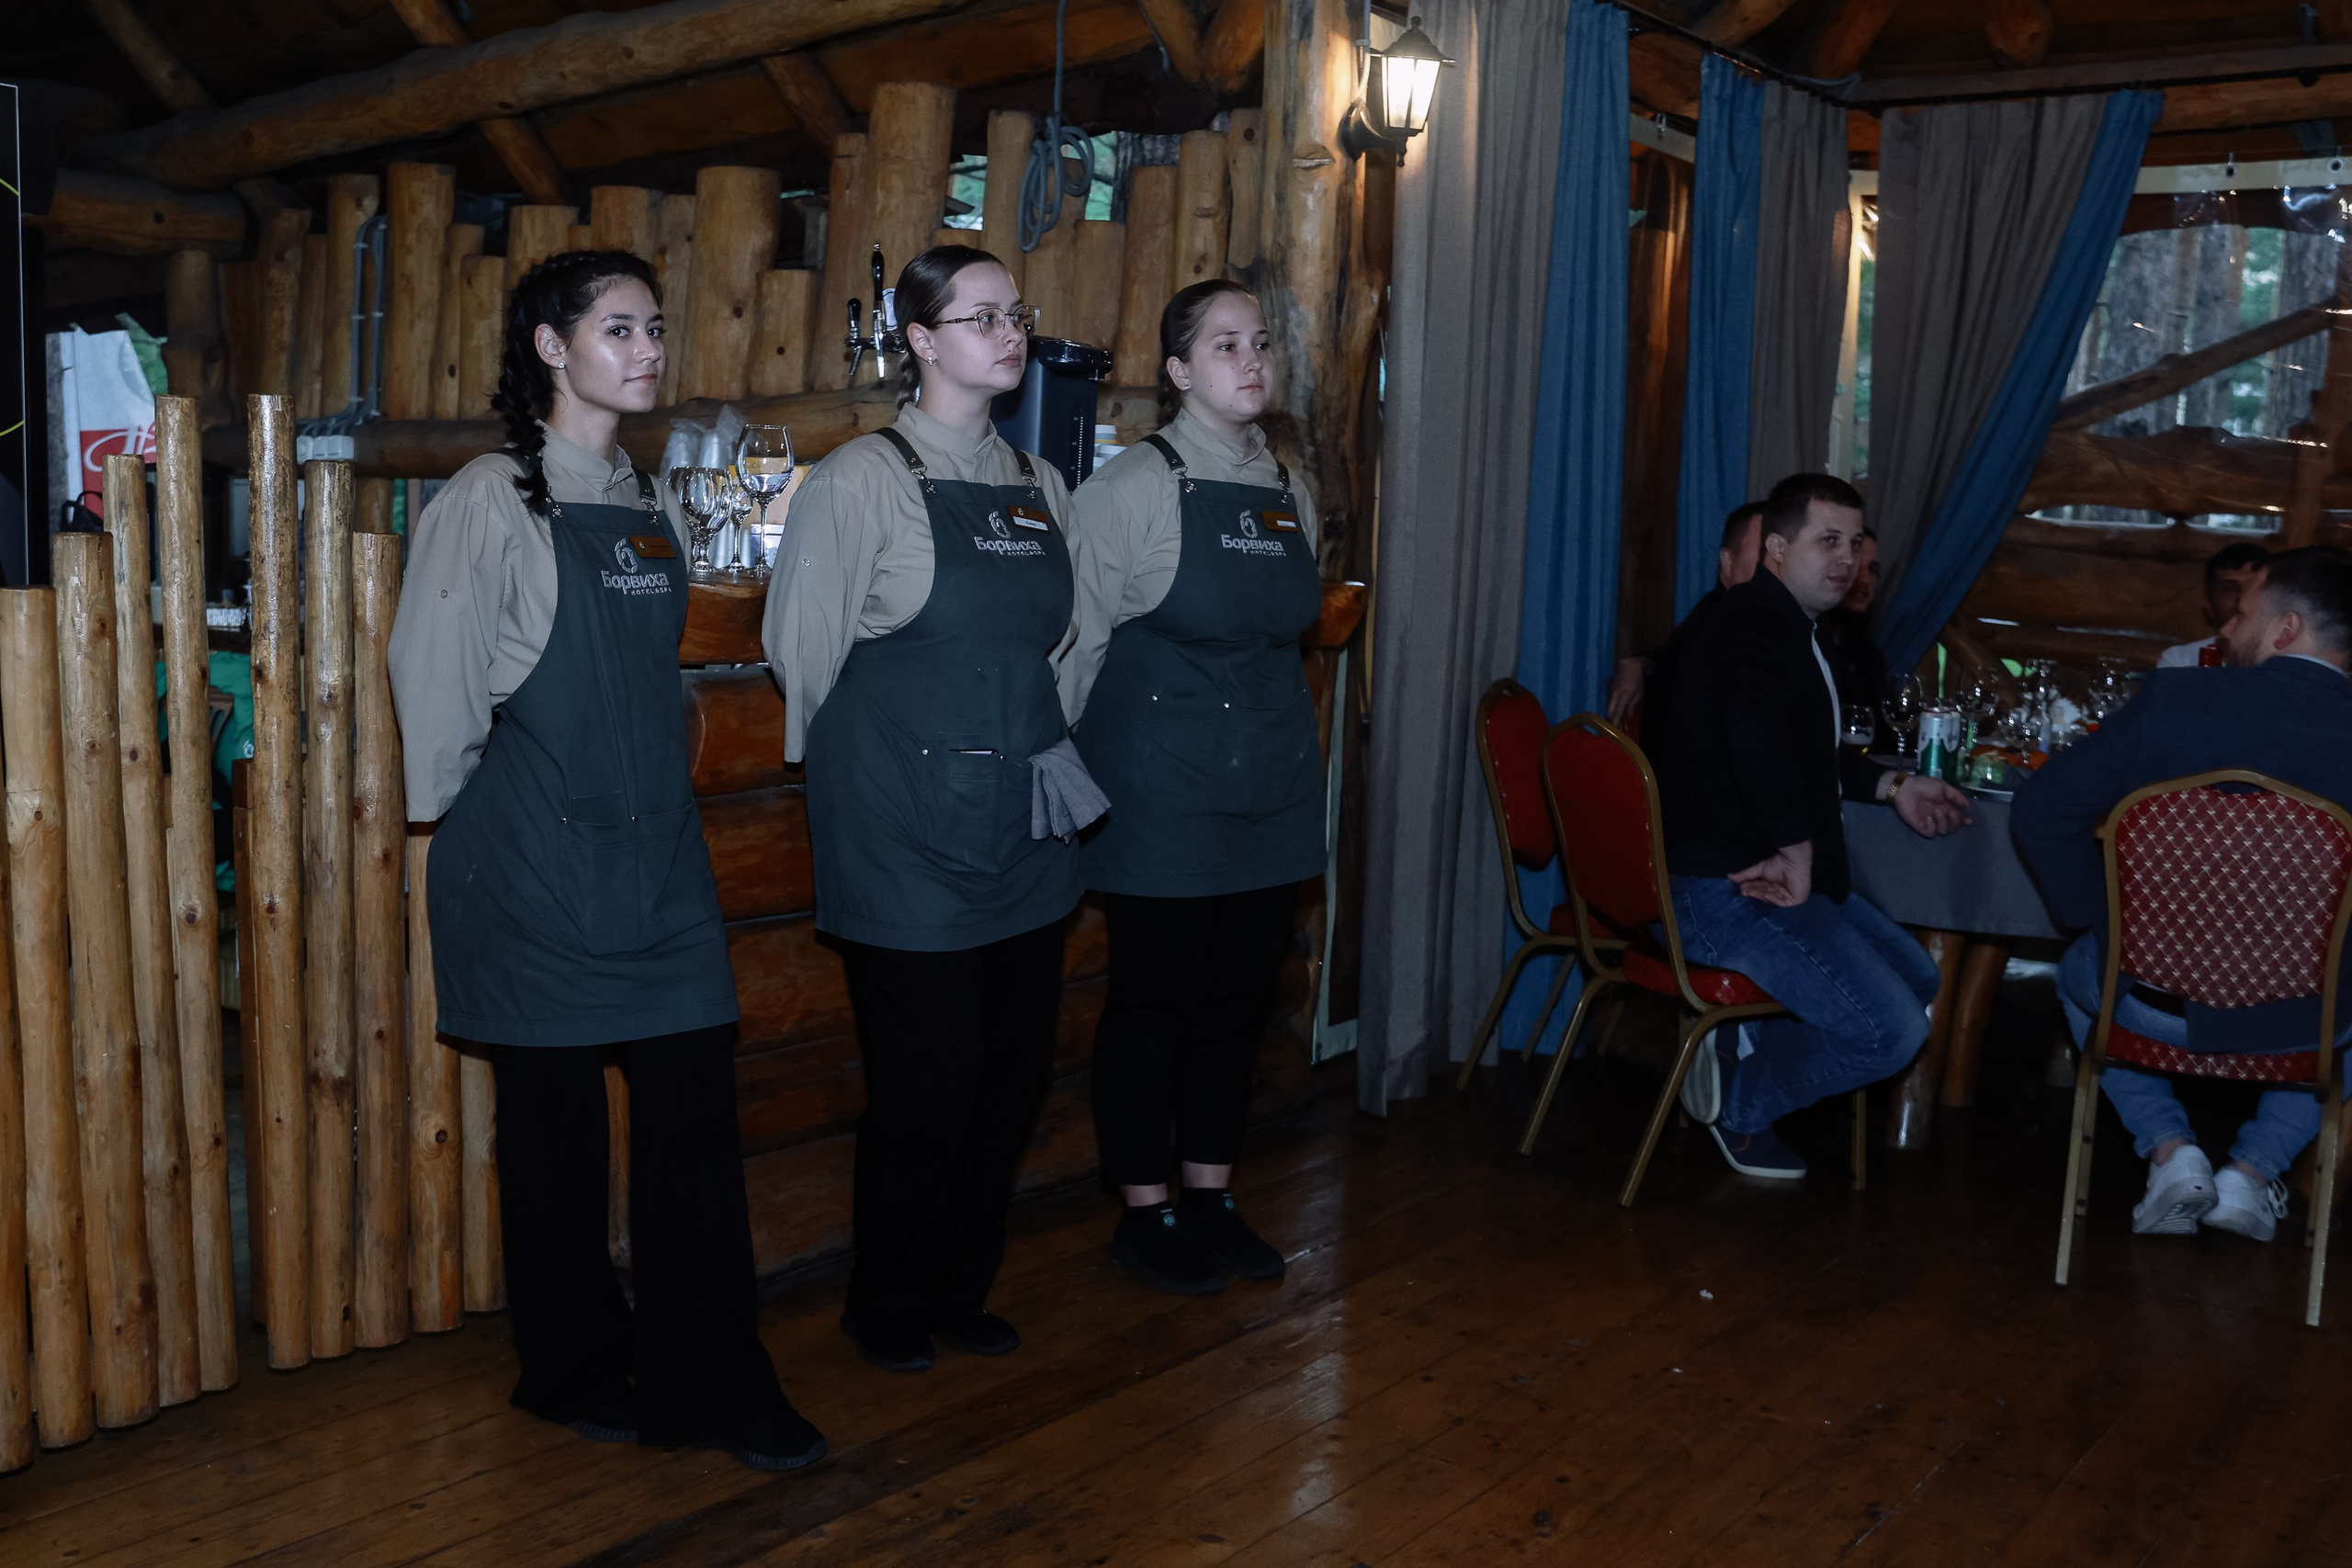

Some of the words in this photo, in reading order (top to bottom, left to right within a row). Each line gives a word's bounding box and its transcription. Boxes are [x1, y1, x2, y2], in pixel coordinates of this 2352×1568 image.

[974, 536, 1042, 555] Борвиха
[1221, 534, 1284, 554] Борвиха
[601, 570, 670, 594] Борвиха
